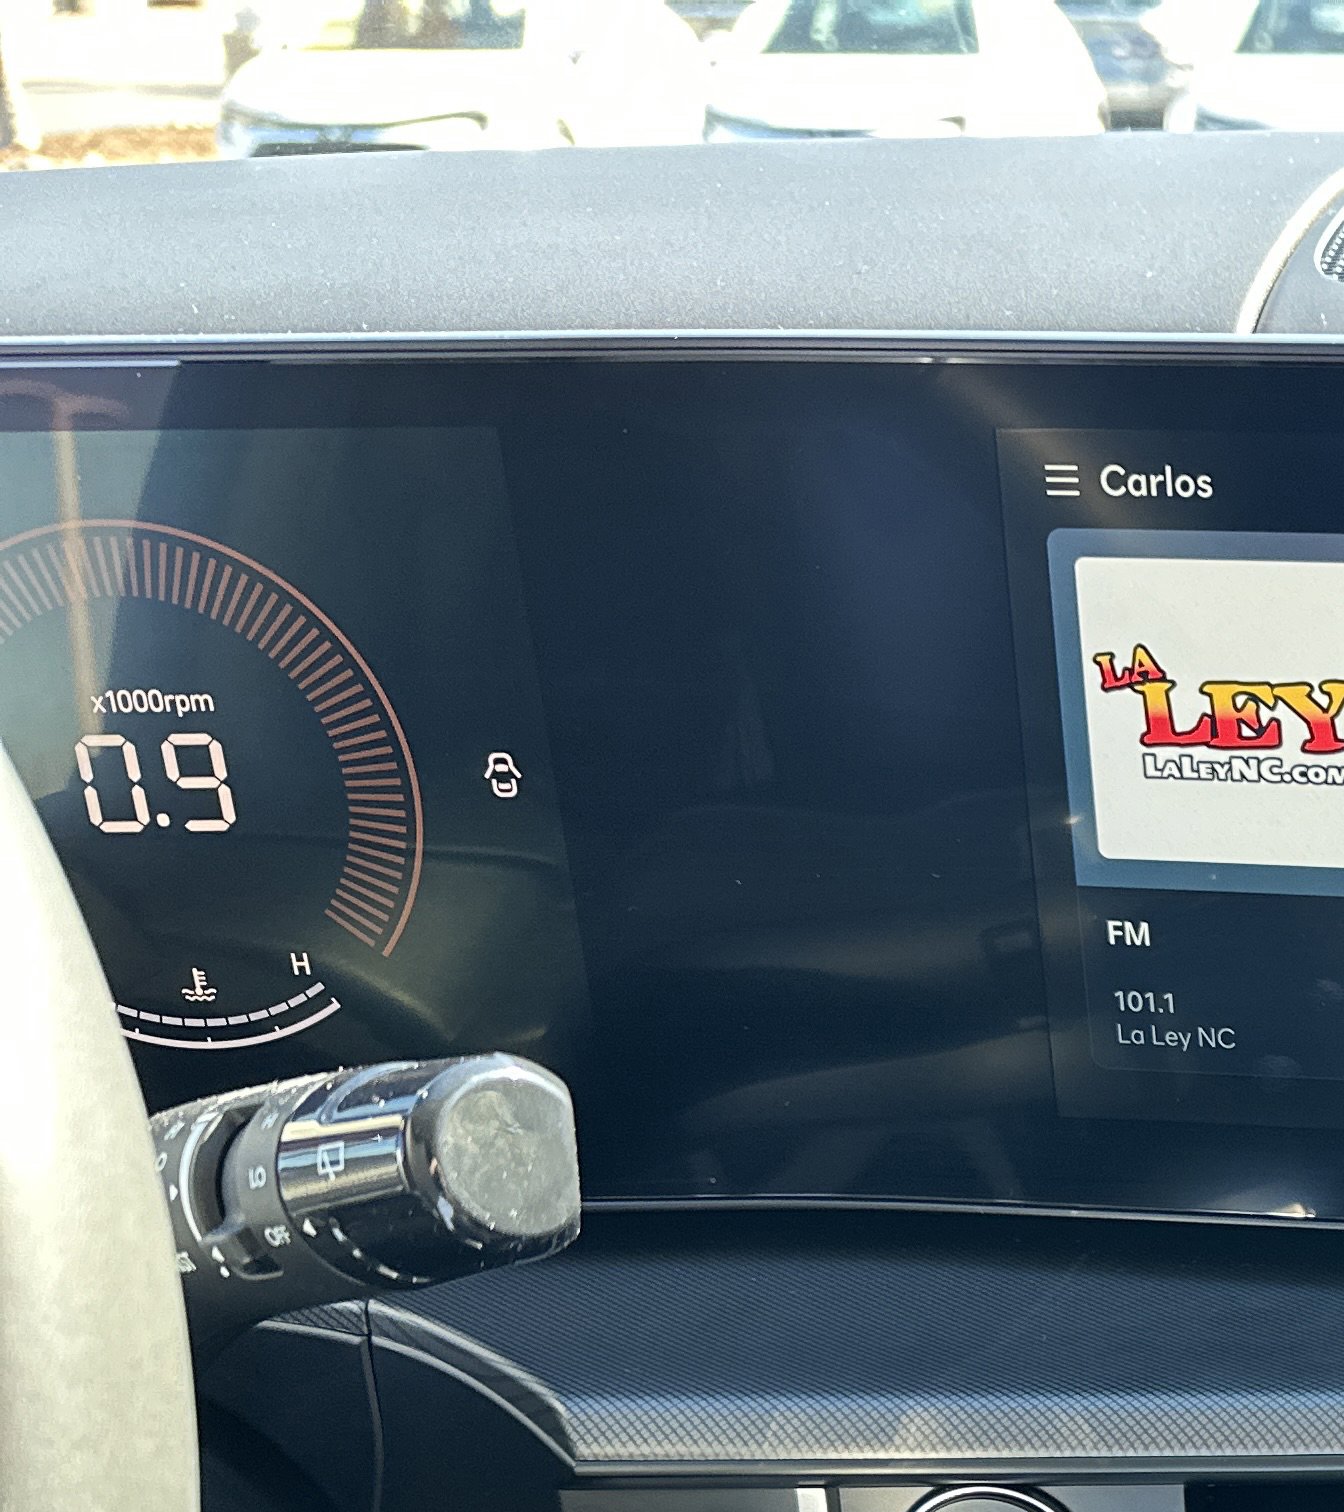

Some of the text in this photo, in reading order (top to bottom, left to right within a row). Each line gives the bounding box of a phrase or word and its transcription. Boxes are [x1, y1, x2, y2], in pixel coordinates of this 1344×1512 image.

[1099, 464, 1213, 499] Carlos
[1093, 643, 1166, 689] LA
[91, 689, 215, 718] x1000rpm
[74, 732, 237, 833] 0.9
[1106, 920, 1151, 947] FM
[290, 952, 312, 976] H
[1114, 990, 1175, 1014] 101.1
[1116, 1023, 1236, 1052] La Ley NC
